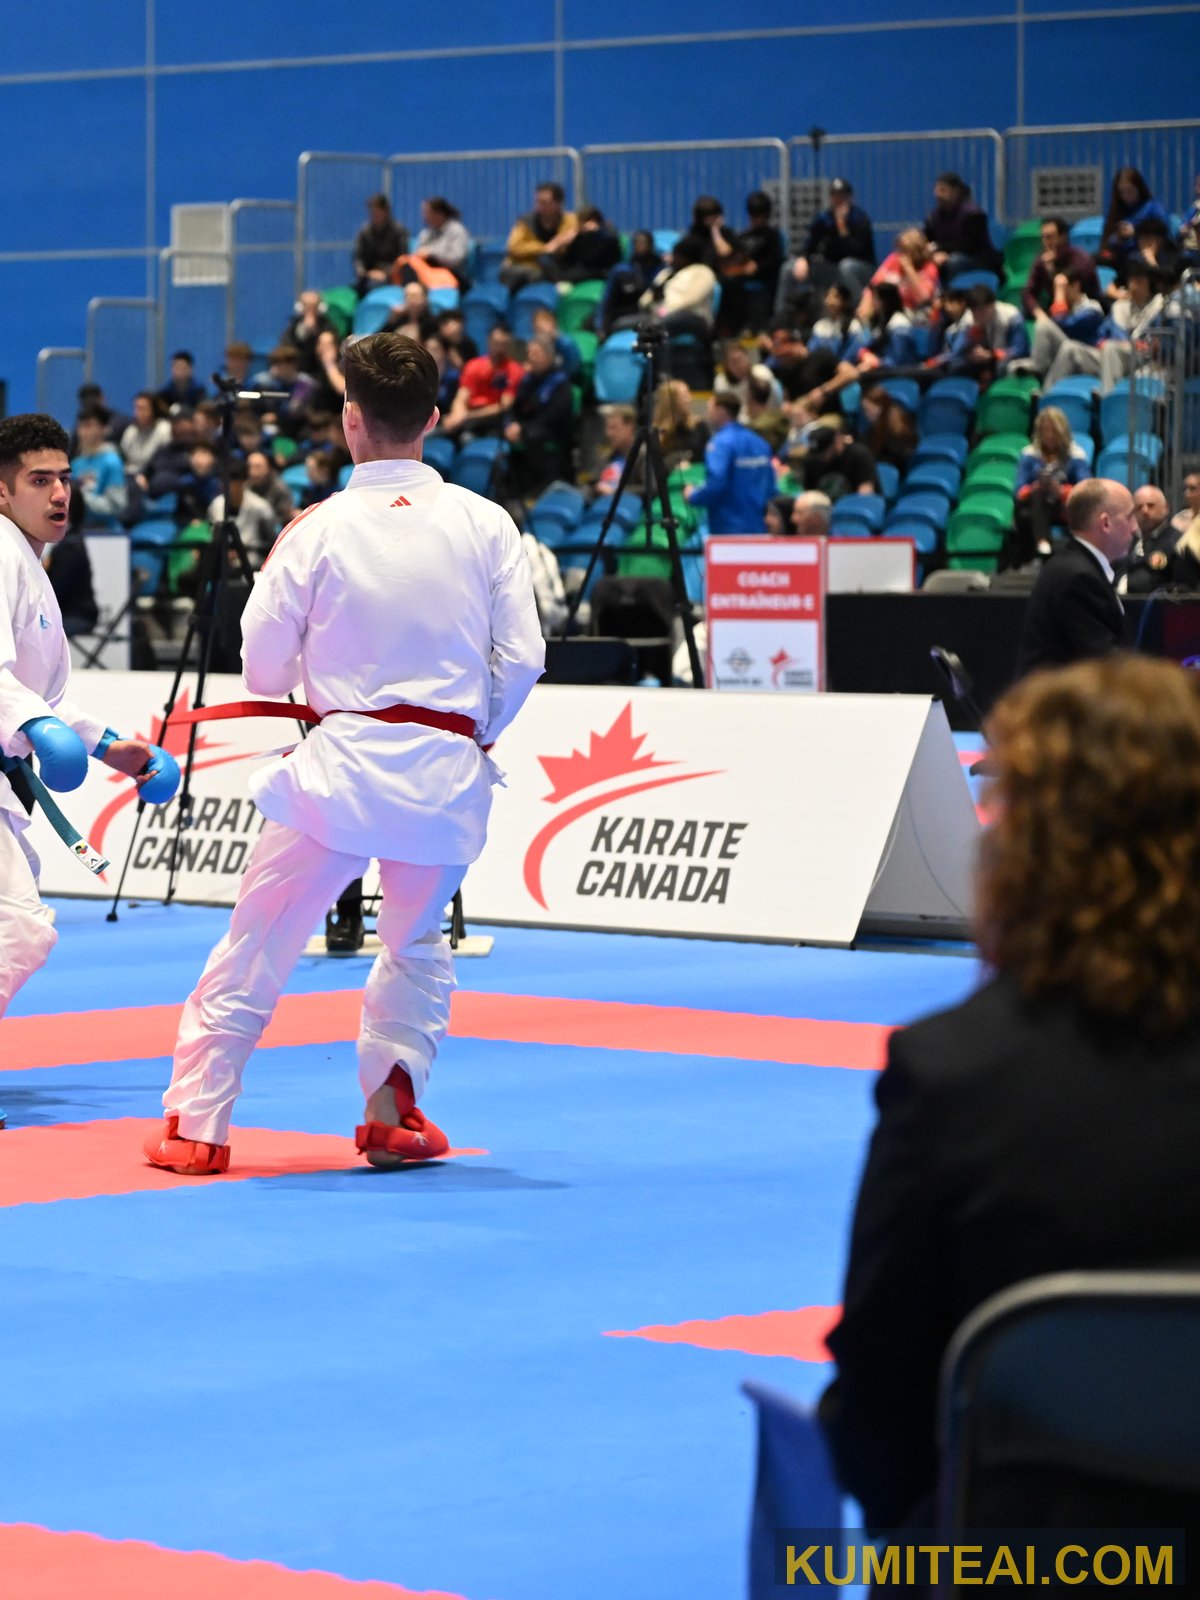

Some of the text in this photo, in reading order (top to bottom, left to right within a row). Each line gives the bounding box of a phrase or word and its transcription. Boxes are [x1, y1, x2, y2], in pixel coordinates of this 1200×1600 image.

[737, 571, 790, 588] COACH
[147, 797, 267, 833] KARAT
[132, 836, 250, 875] CANAD
[590, 816, 749, 859] KARATE
[576, 860, 731, 904] CANADA
